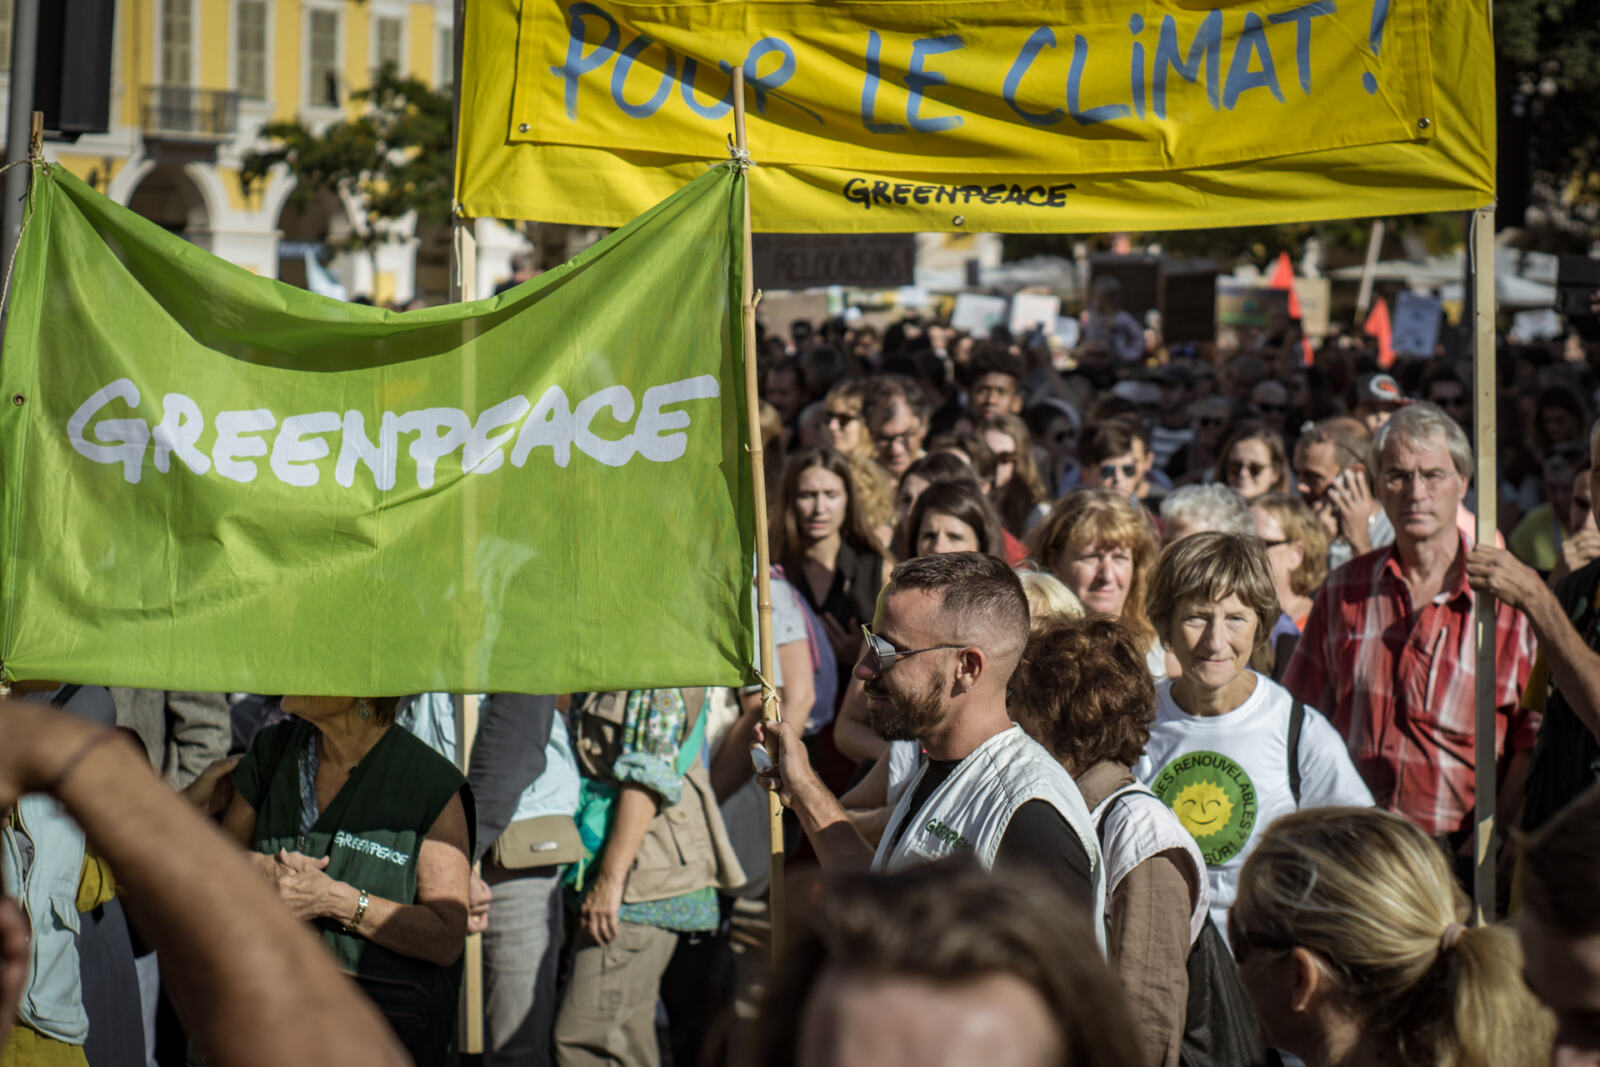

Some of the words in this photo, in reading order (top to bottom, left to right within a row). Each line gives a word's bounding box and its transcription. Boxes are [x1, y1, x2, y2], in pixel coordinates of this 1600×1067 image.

[550, 2, 825, 124] POUR
[861, 30, 964, 134] LE
[843, 178, 1076, 209] GREENPEACE
[67, 374, 719, 490] GREENPEACE
[334, 830, 409, 866] GREENPEACE
